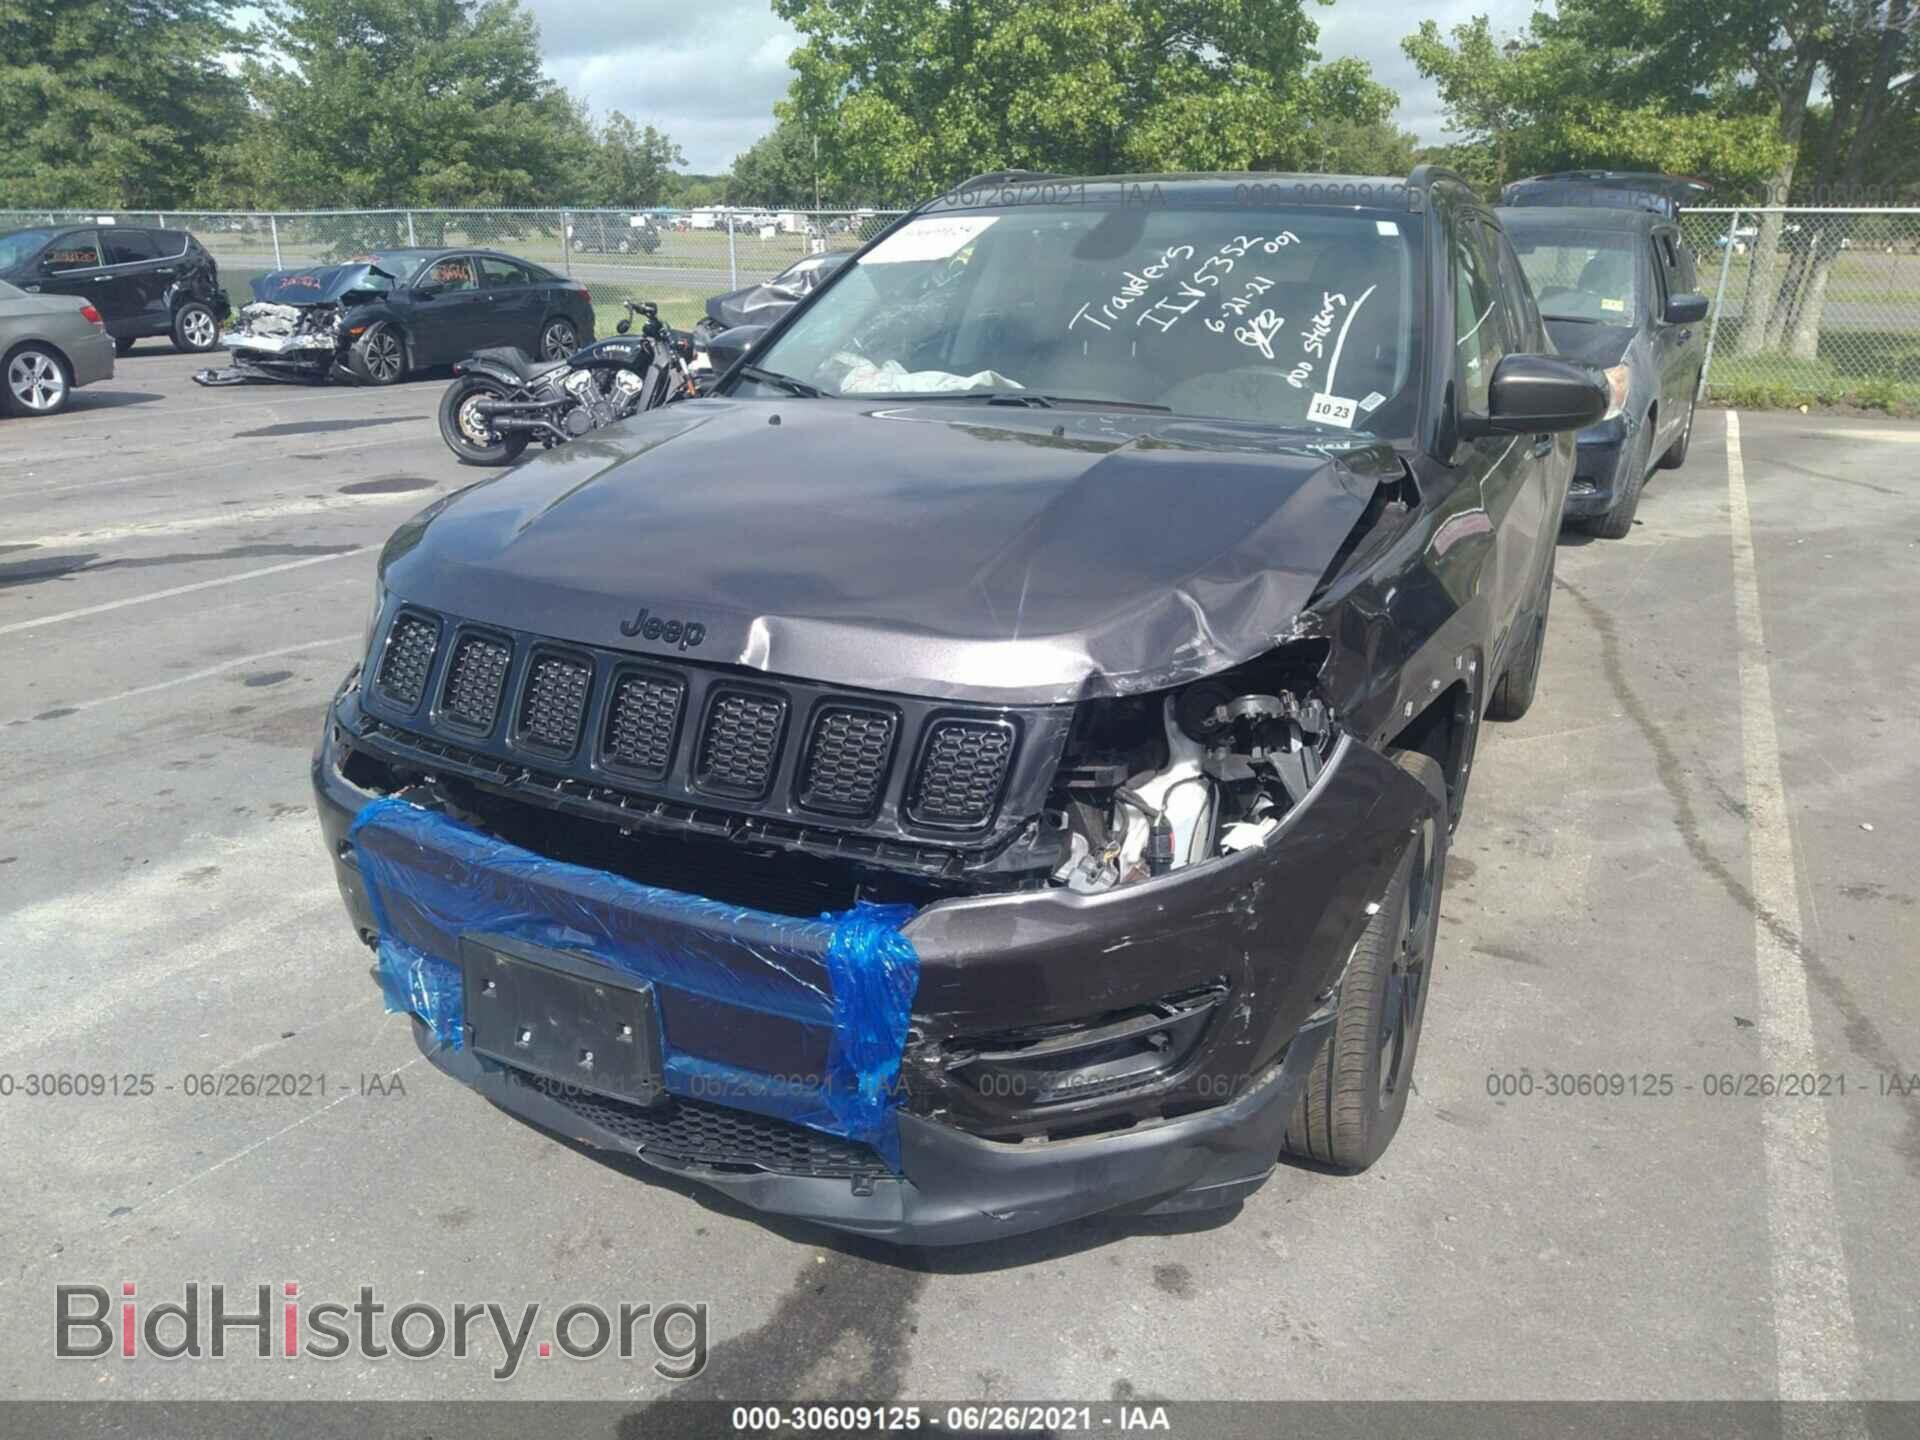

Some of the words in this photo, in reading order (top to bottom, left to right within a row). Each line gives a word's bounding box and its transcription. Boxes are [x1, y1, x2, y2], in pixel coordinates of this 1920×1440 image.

[1315, 402, 1332, 415] 10
[1333, 406, 1350, 419] 23
[620, 608, 706, 651] Jeep
